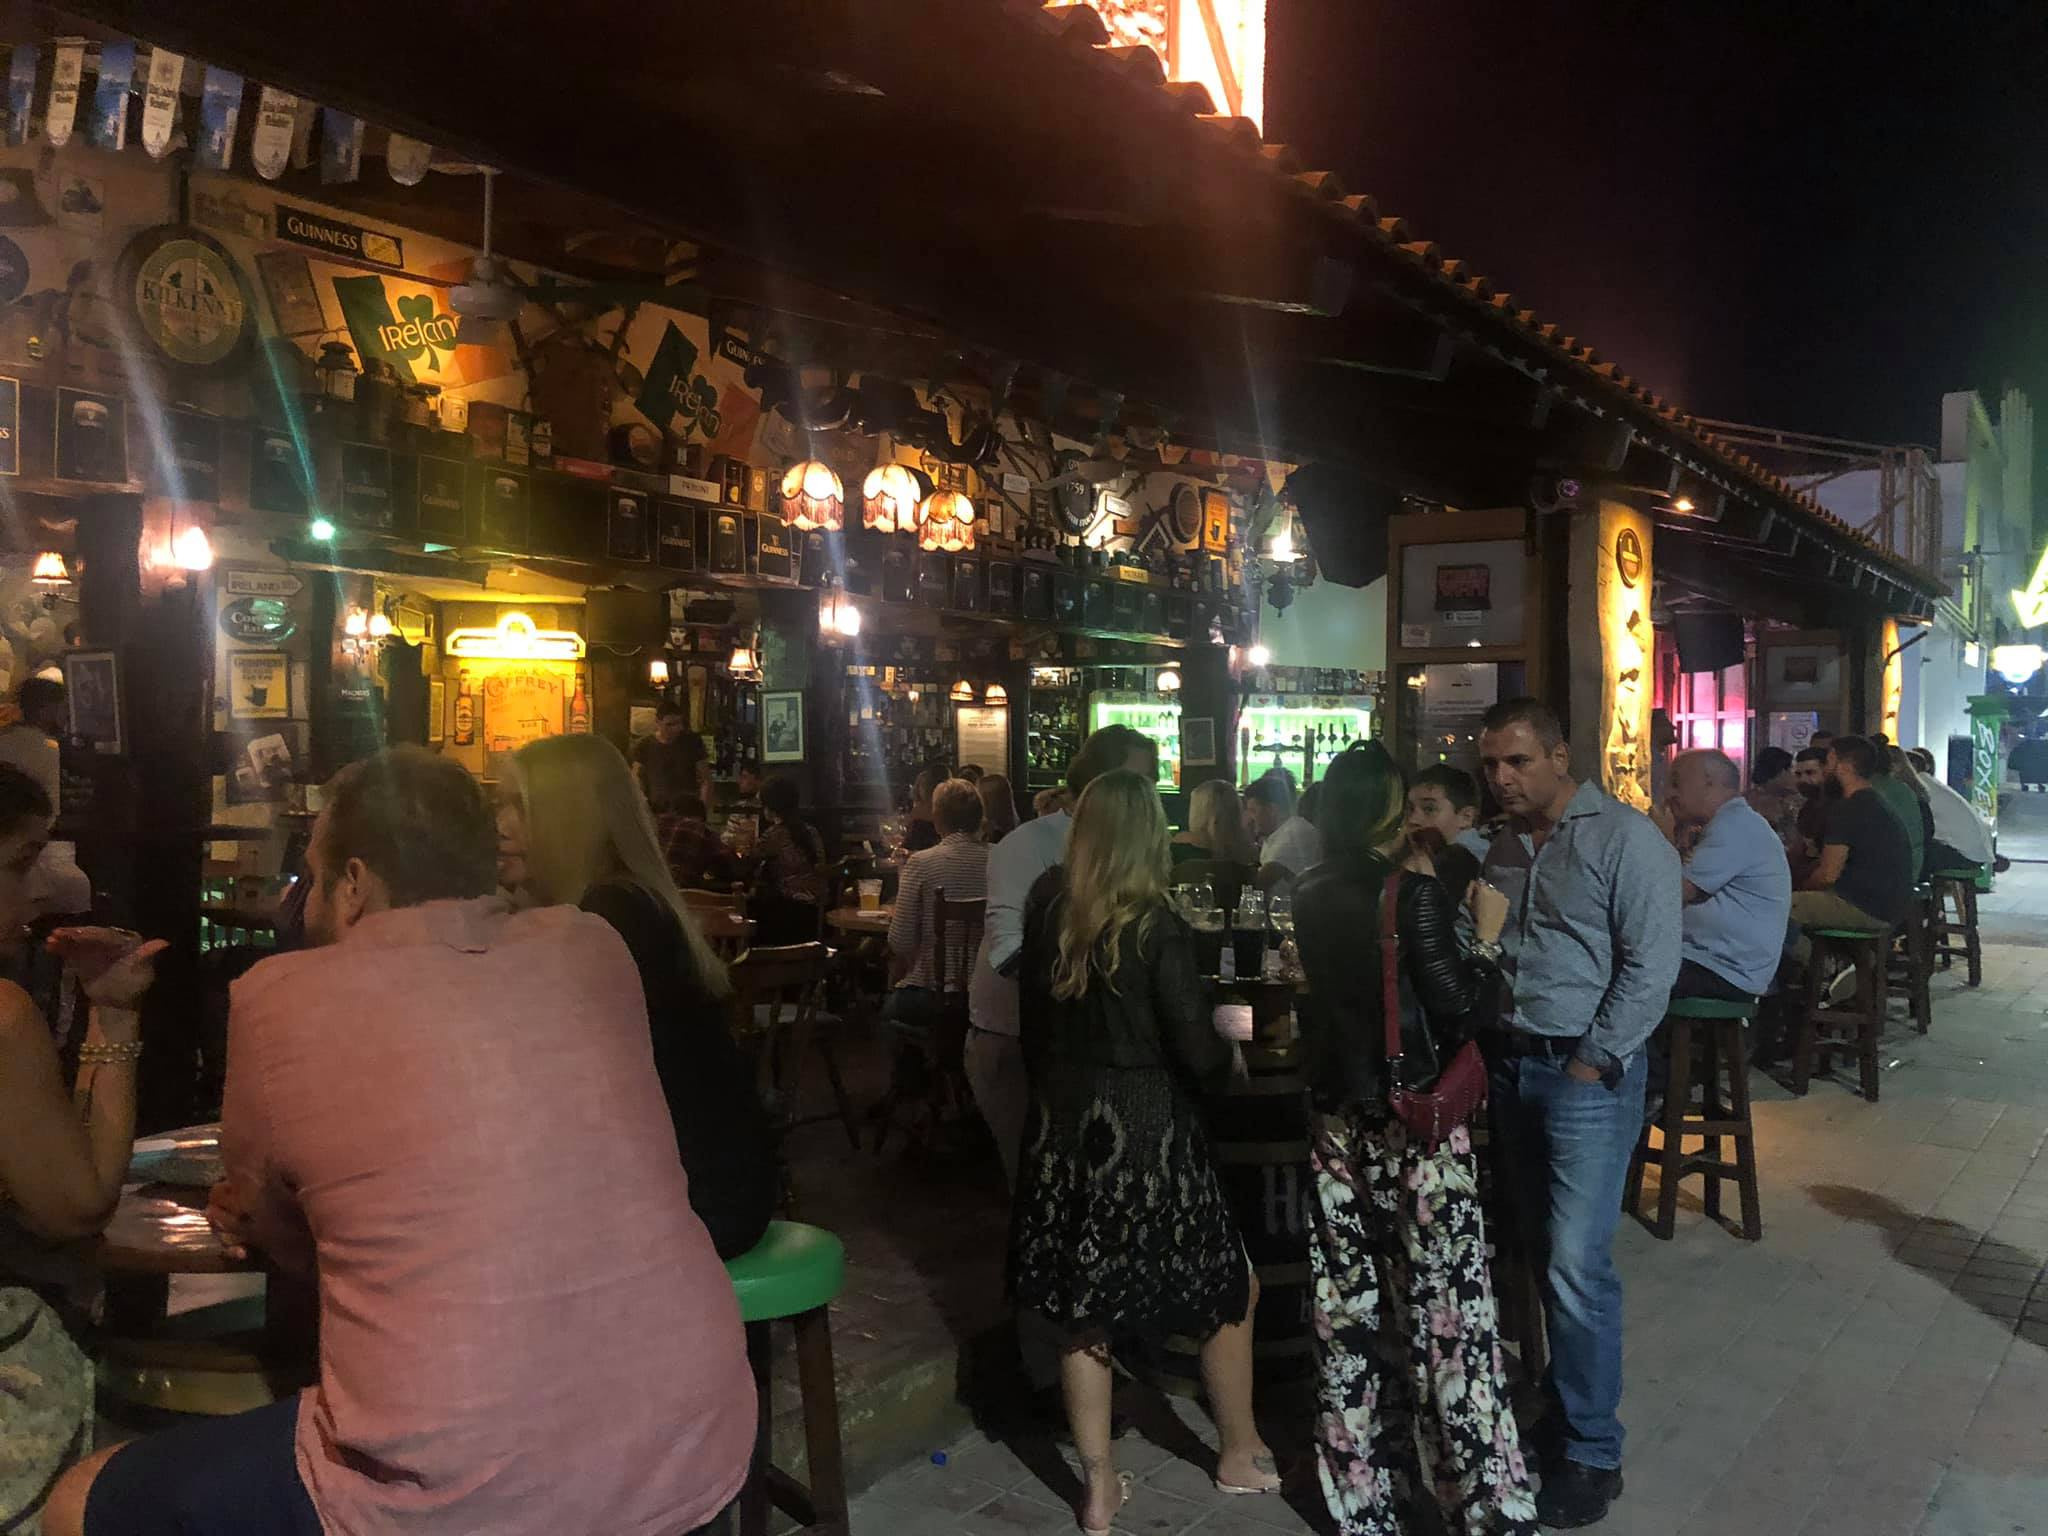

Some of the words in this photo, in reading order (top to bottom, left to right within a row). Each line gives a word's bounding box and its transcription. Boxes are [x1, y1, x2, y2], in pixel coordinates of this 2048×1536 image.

[286, 216, 359, 251] GUINNESS
[143, 279, 241, 321] KILKENNY
[761, 542, 790, 557] GUINNESS
